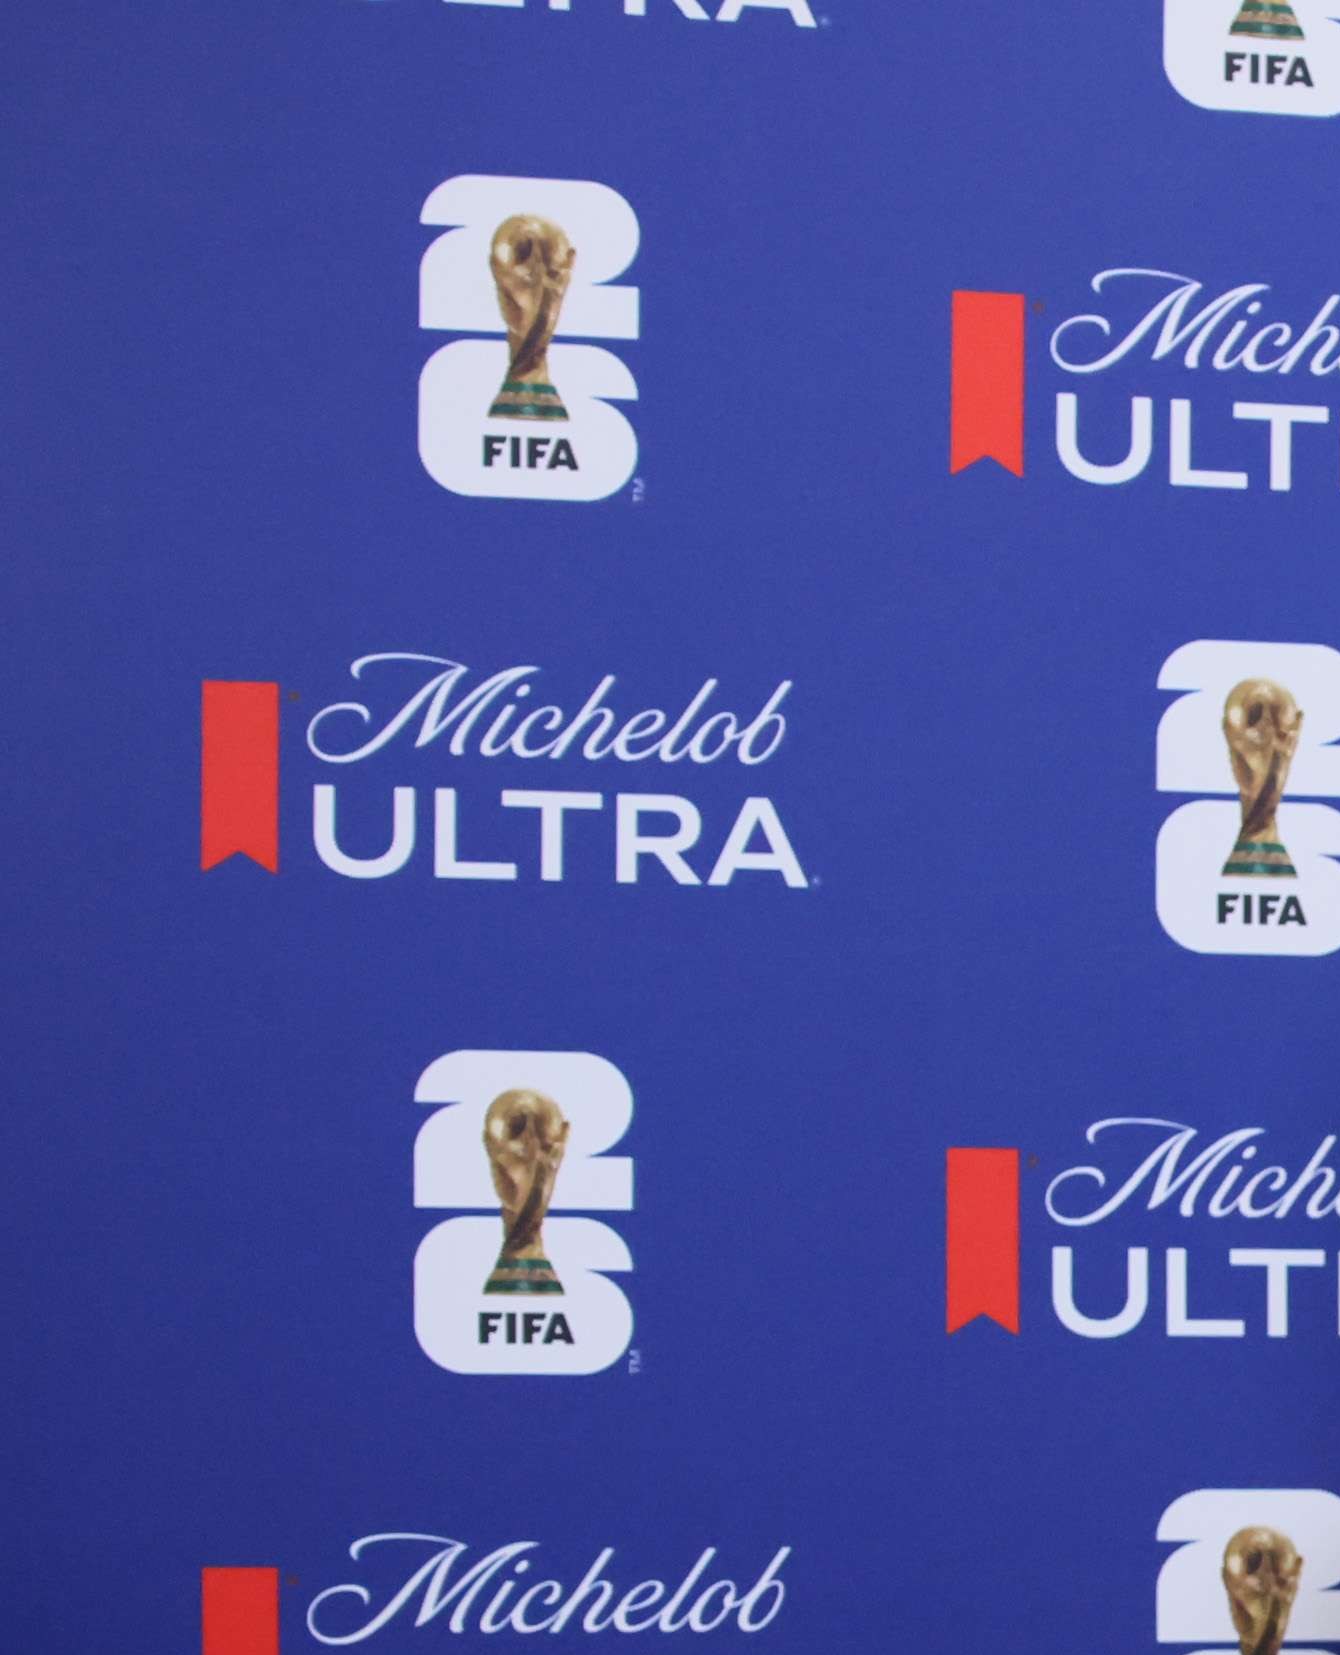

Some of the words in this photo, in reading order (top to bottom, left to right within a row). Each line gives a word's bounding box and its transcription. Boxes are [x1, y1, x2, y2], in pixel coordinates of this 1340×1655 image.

[1224, 51, 1314, 88] FIFA
[483, 435, 579, 471] FIFA
[307, 653, 792, 765] Michelob
[314, 785, 808, 888] ULTRA
[1217, 893, 1307, 926] FIFA
[478, 1312, 575, 1345] FIFA
[307, 1533, 791, 1645] Michelob
